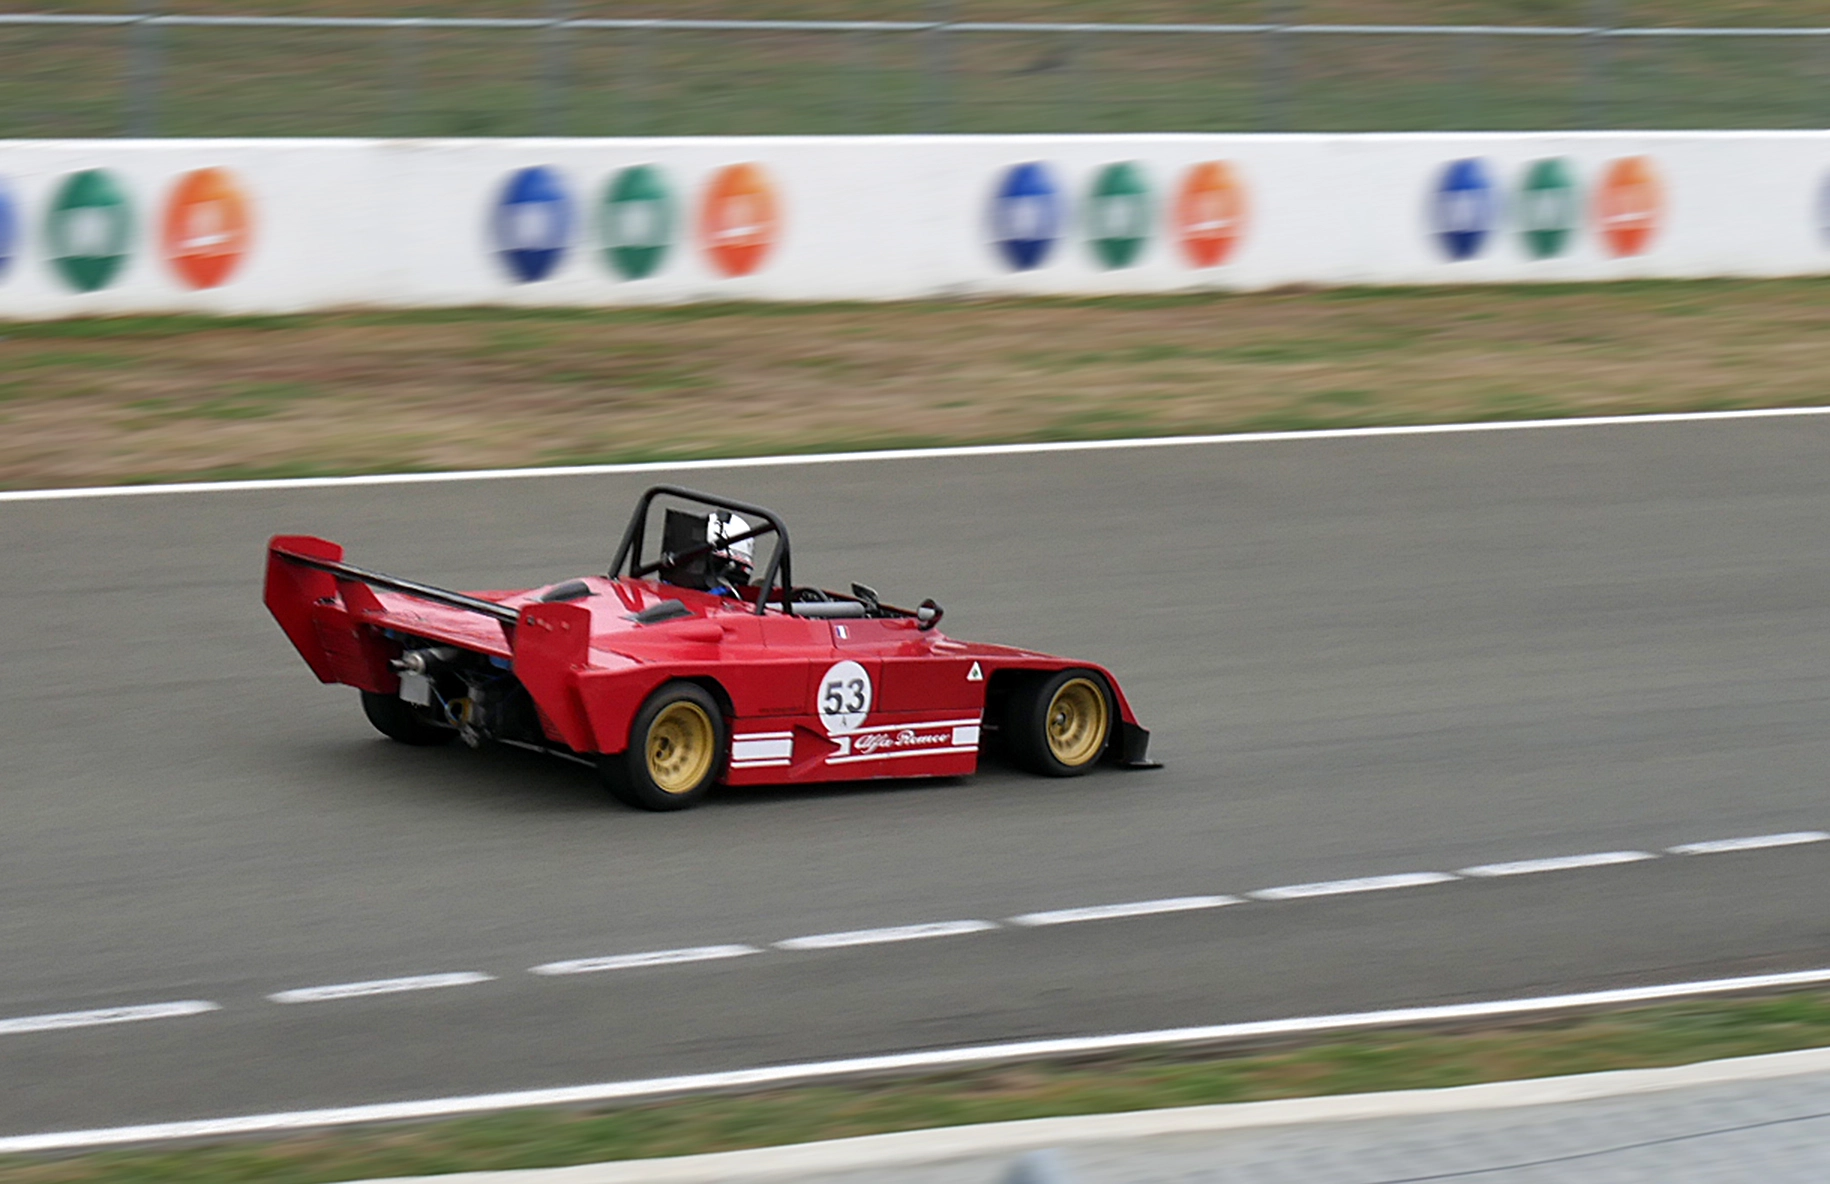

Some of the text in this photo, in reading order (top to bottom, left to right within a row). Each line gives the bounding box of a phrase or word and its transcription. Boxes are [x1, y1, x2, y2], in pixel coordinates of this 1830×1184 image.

[823, 678, 865, 715] 53
[854, 729, 950, 754] Alfa Romeo
